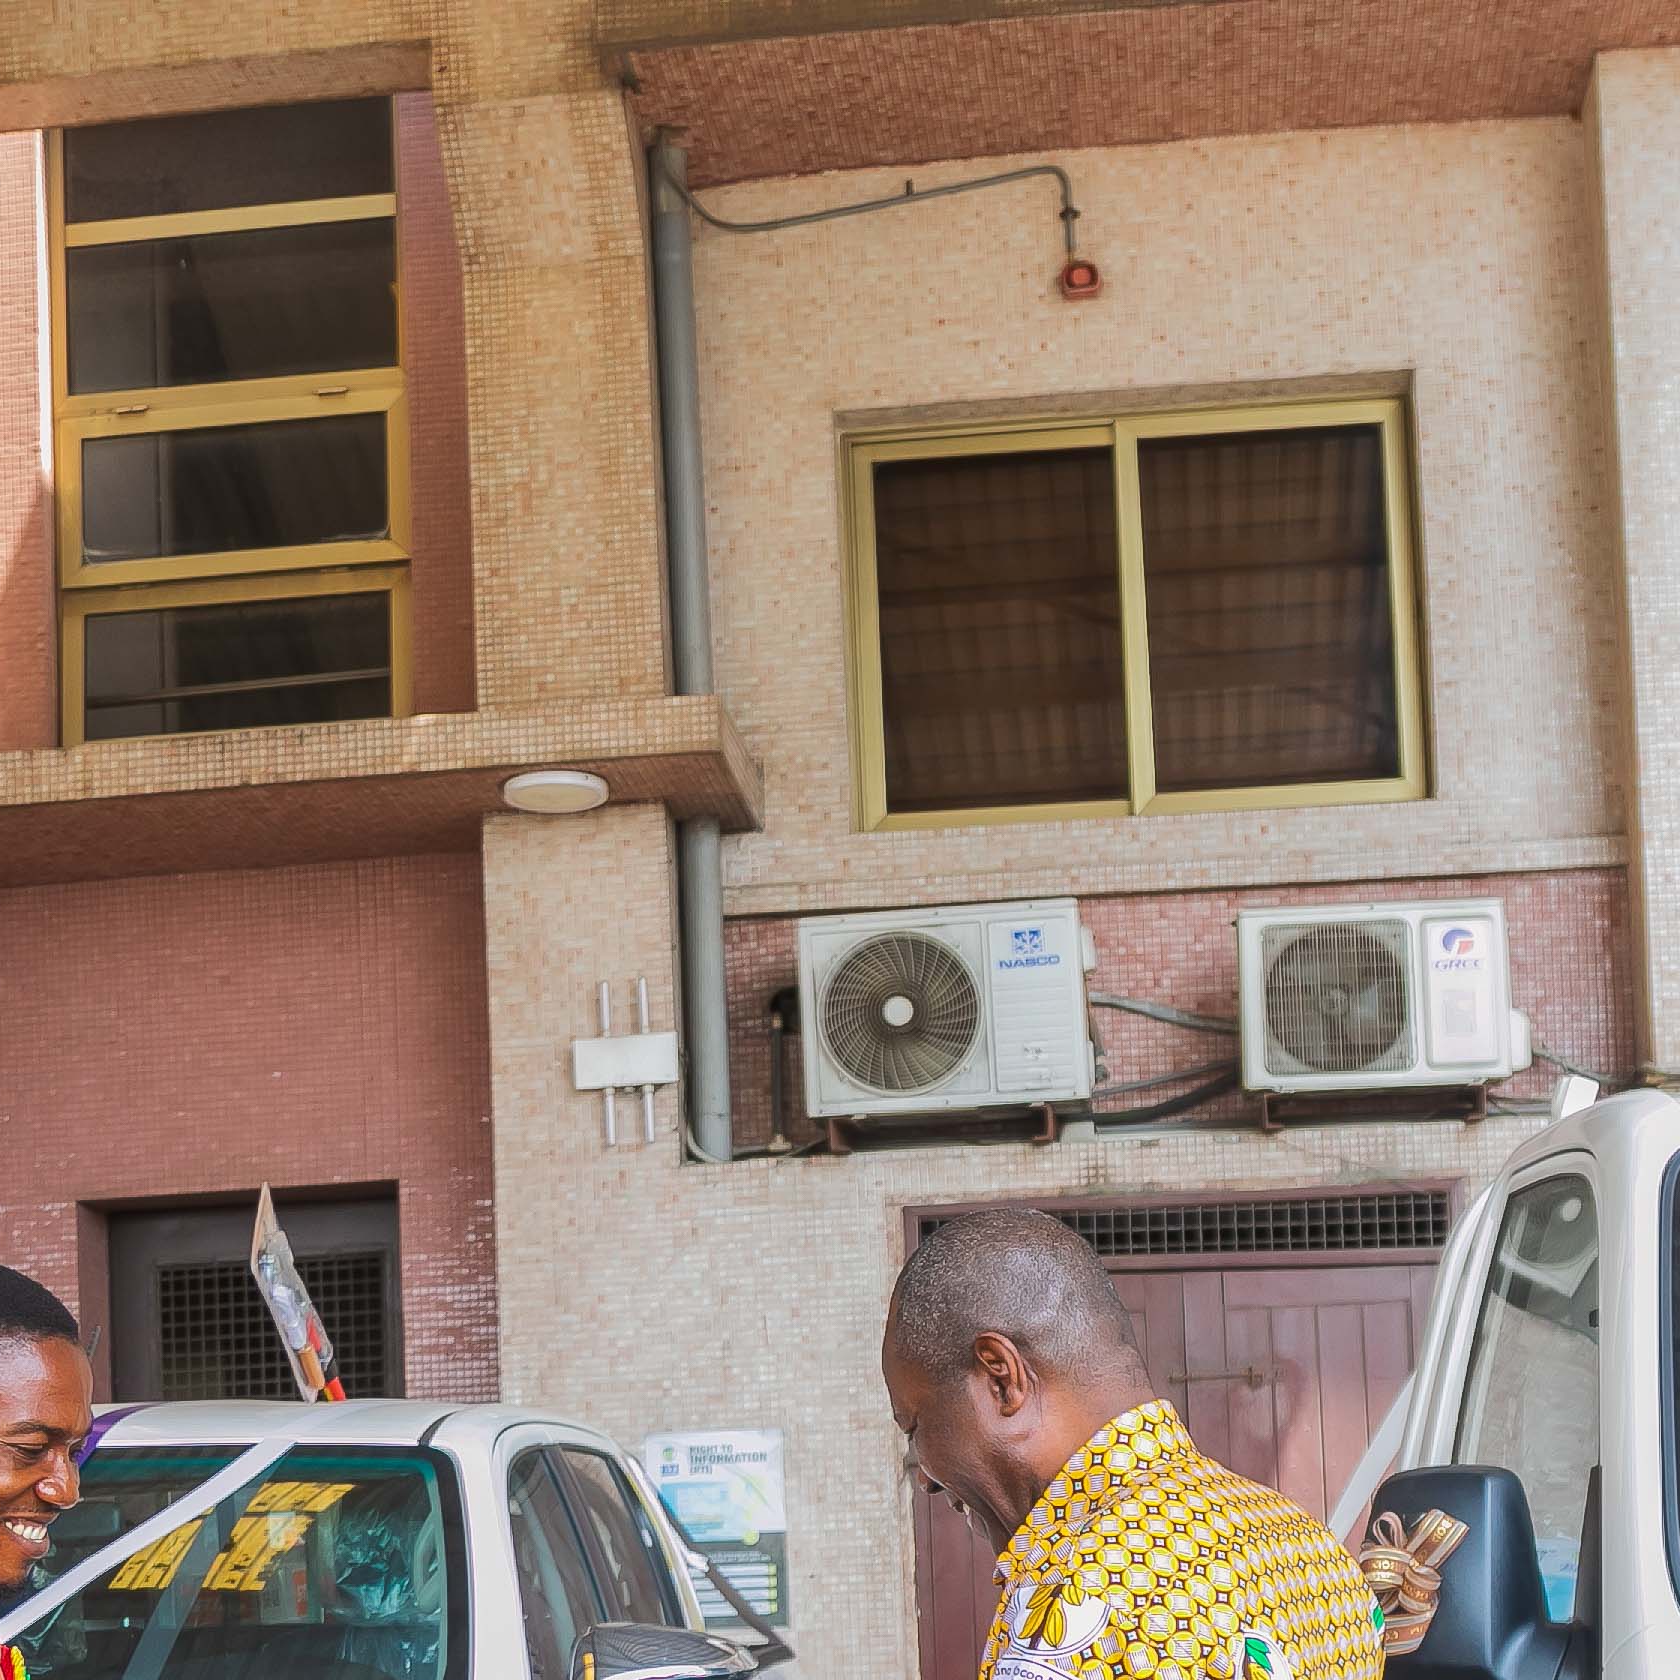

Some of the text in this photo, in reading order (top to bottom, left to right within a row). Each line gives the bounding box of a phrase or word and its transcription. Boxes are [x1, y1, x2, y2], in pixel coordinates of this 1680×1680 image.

[998, 954, 1061, 969] NASCO
[688, 1444, 734, 1456] RIGHT TO
[689, 1451, 768, 1465] INFORMATION
